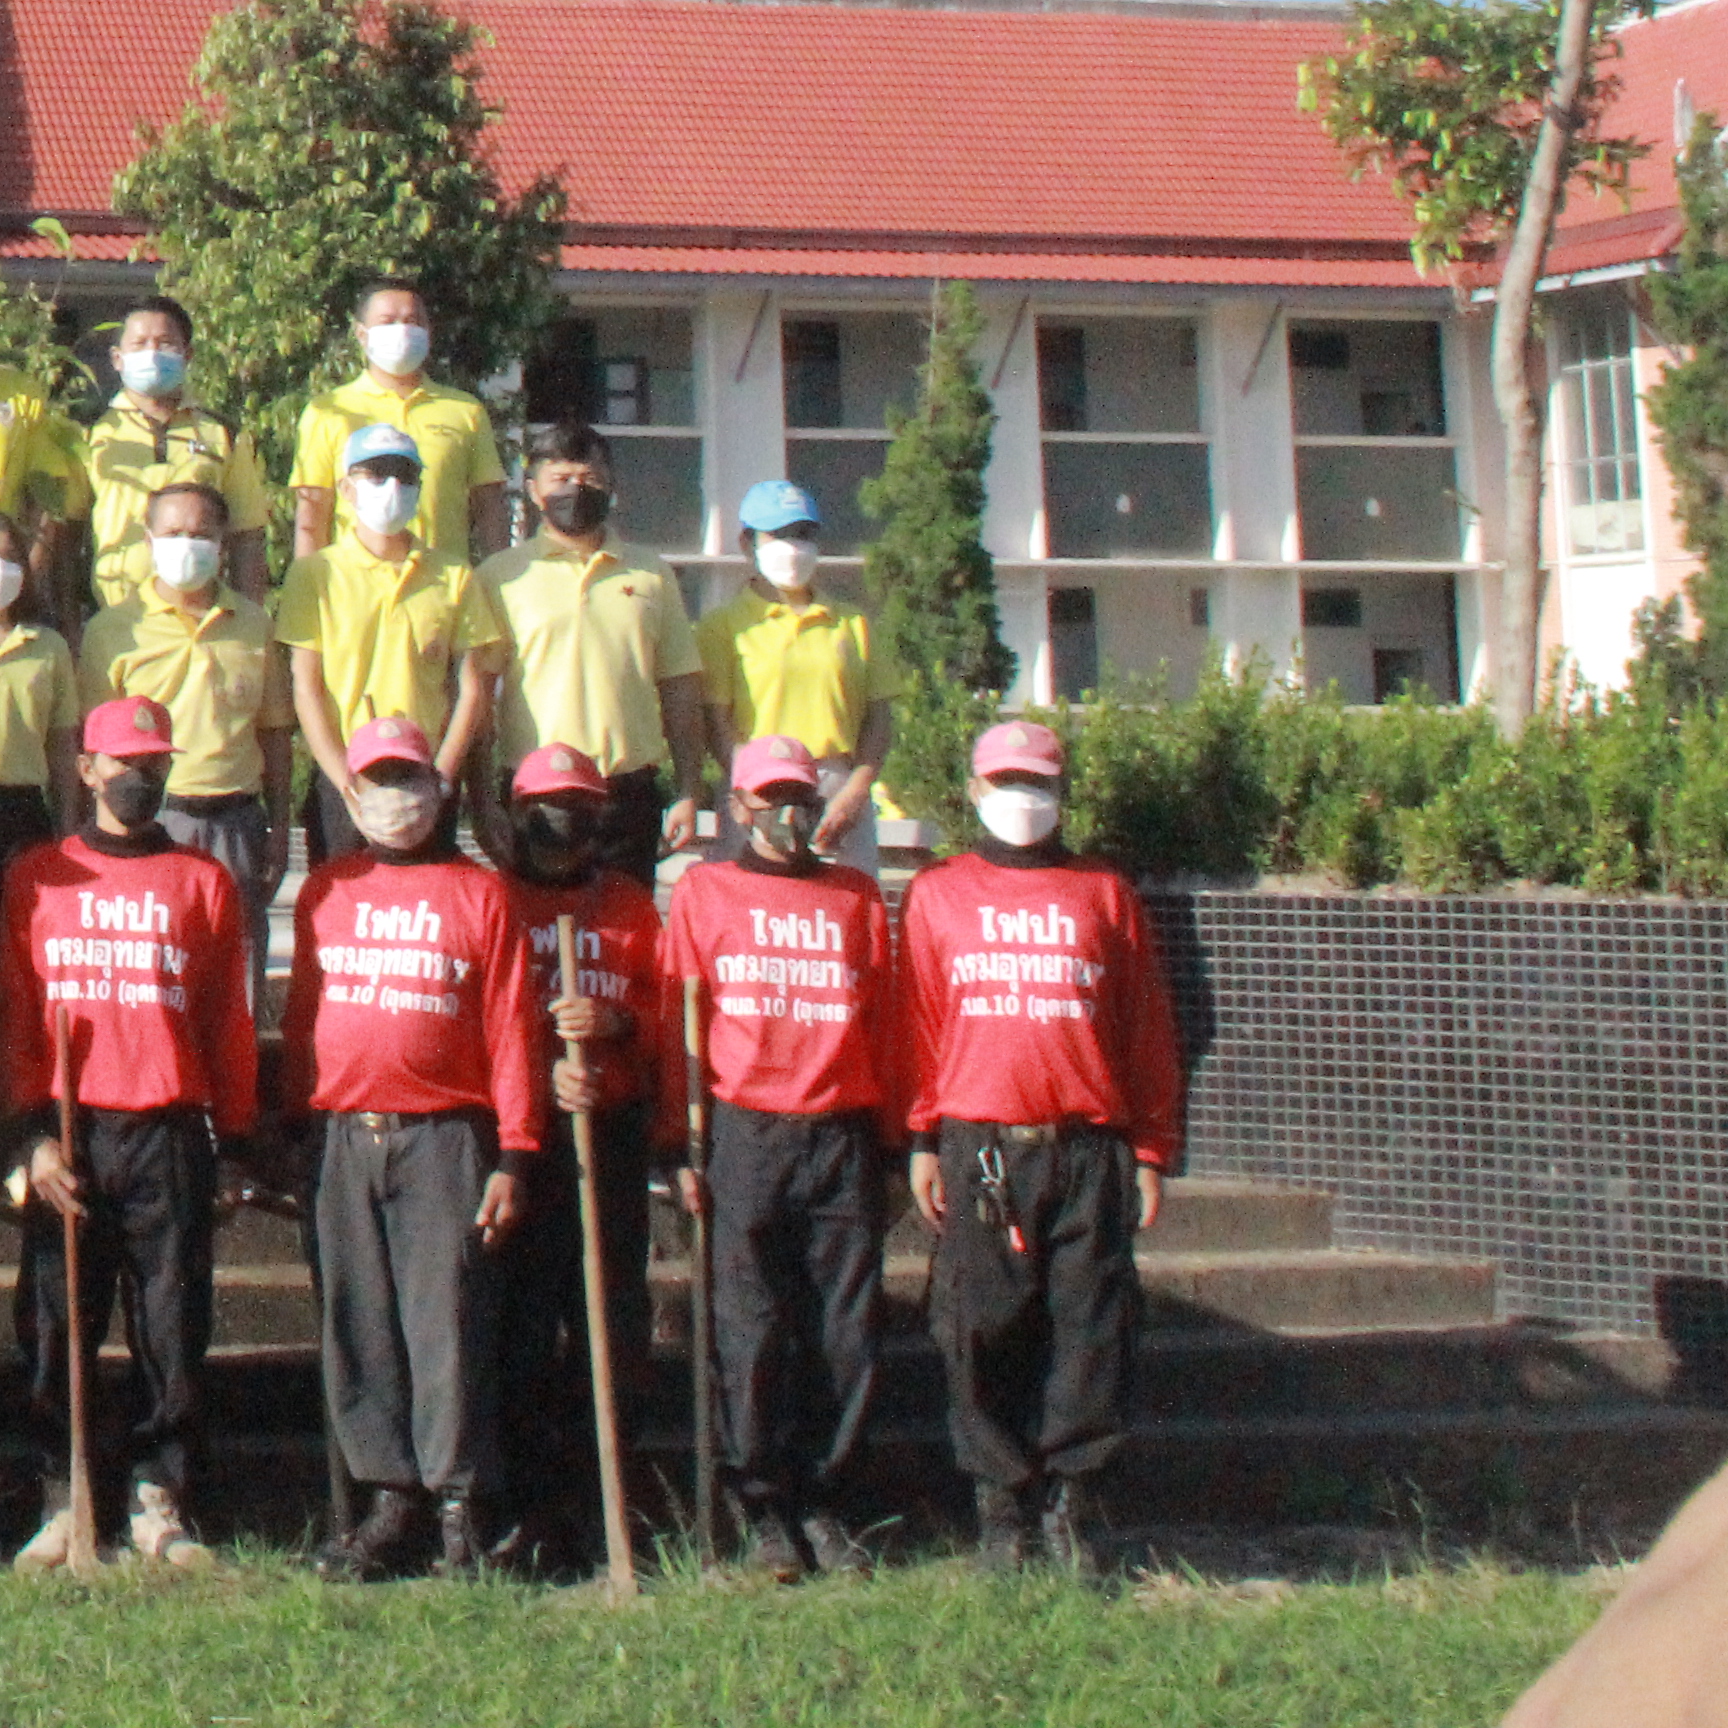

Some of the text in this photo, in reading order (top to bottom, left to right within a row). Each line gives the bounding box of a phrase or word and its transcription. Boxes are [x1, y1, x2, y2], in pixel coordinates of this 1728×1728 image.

[78, 891, 170, 934] ไฟป่า
[355, 900, 442, 942] ไฟป่า
[749, 908, 842, 952] ไฟป่า
[978, 903, 1076, 946] ไฟป่า
